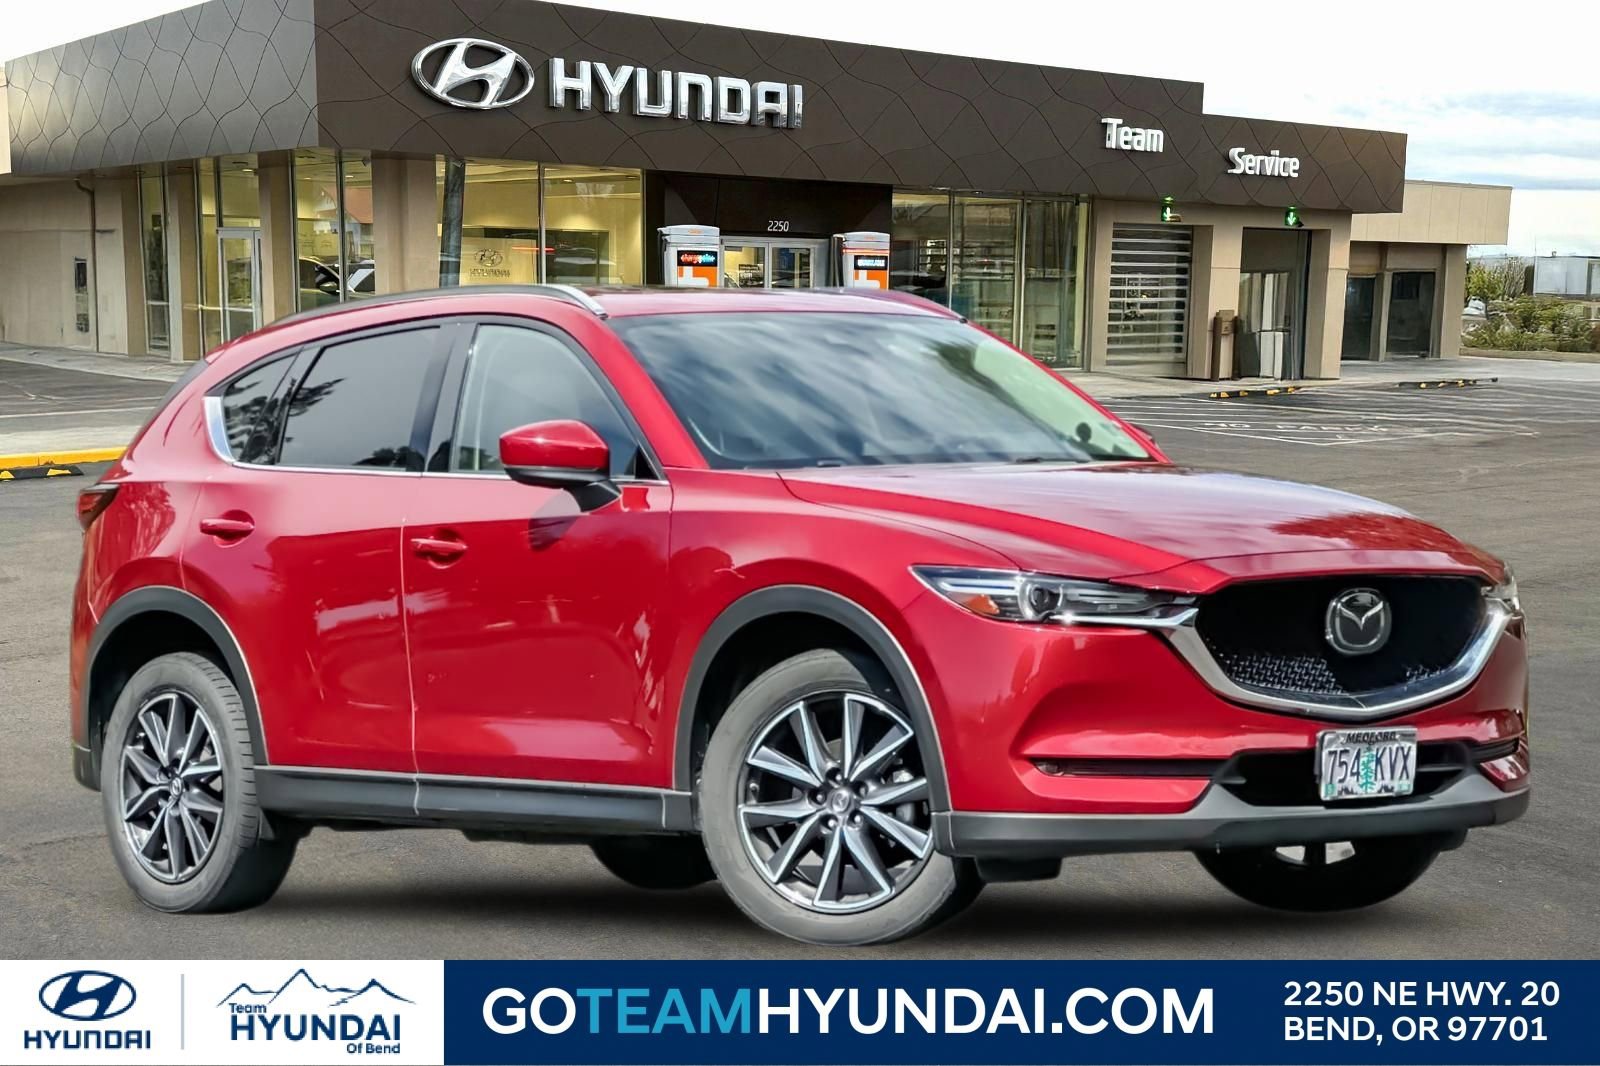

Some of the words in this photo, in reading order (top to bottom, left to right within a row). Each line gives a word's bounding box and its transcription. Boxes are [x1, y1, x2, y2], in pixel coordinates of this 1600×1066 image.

[549, 57, 804, 129] HYUNDAI
[1101, 117, 1164, 152] Team
[1227, 147, 1300, 178] Service
[767, 220, 790, 232] 2250
[1327, 748, 1361, 784] 754
[1374, 746, 1412, 782] KVX
